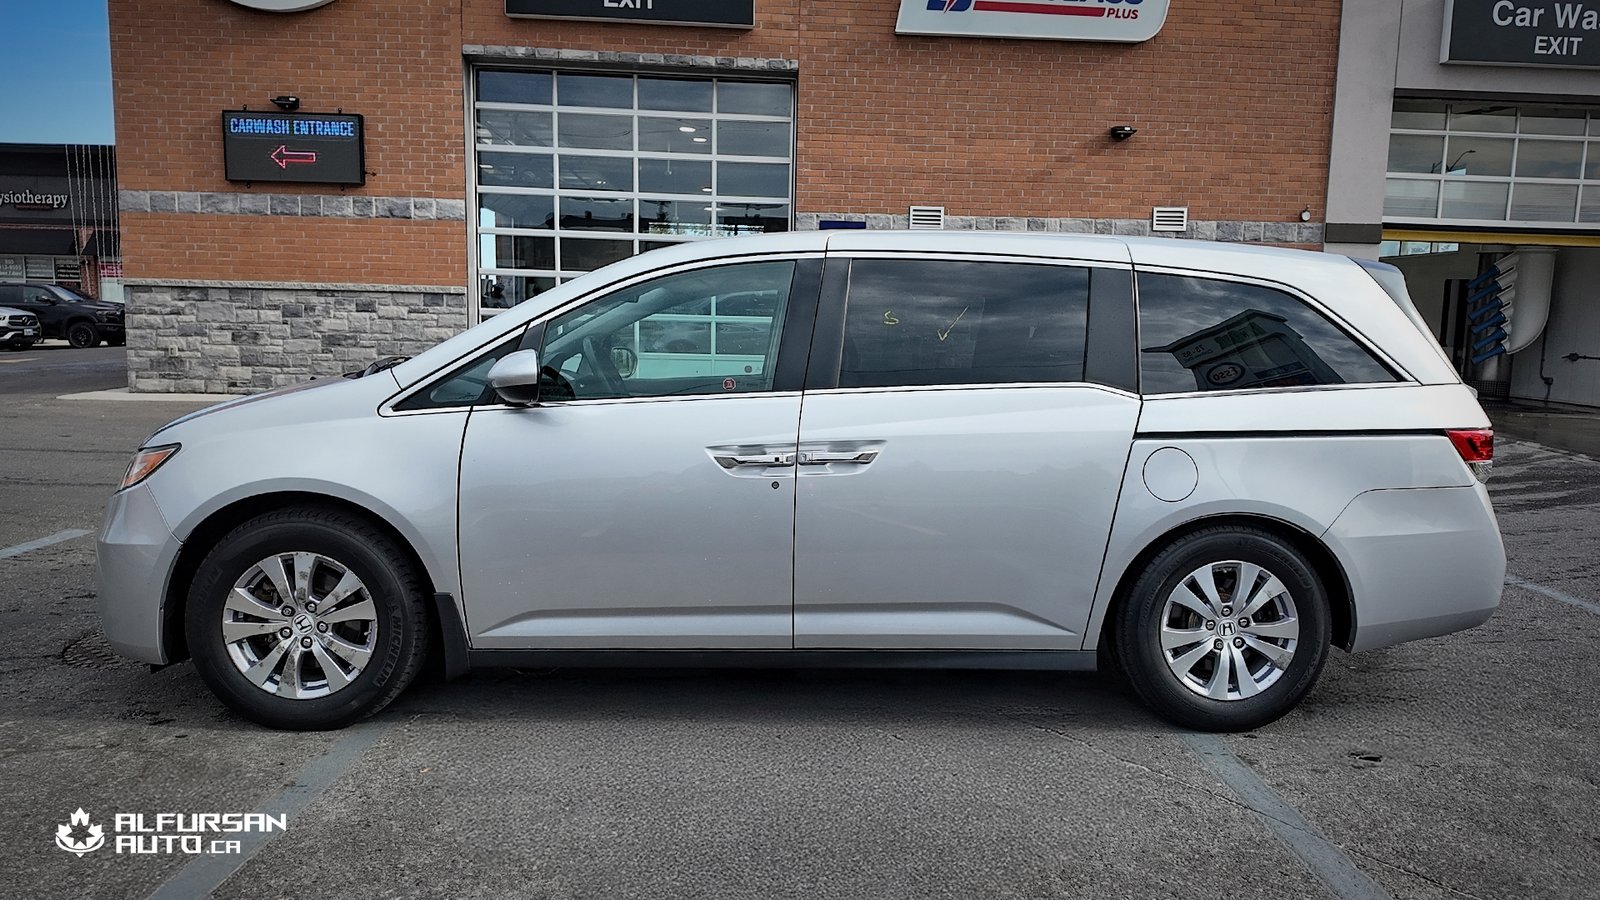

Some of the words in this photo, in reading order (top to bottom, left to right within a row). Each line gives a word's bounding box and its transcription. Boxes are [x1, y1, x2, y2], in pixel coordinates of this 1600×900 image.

[1106, 8, 1139, 20] PLUS
[1492, 0, 1545, 27] Car
[1554, 2, 1600, 30] Wa
[1534, 35, 1583, 56] EXIT
[230, 117, 290, 135] CARWASH
[293, 120, 354, 136] ENTRANCE
